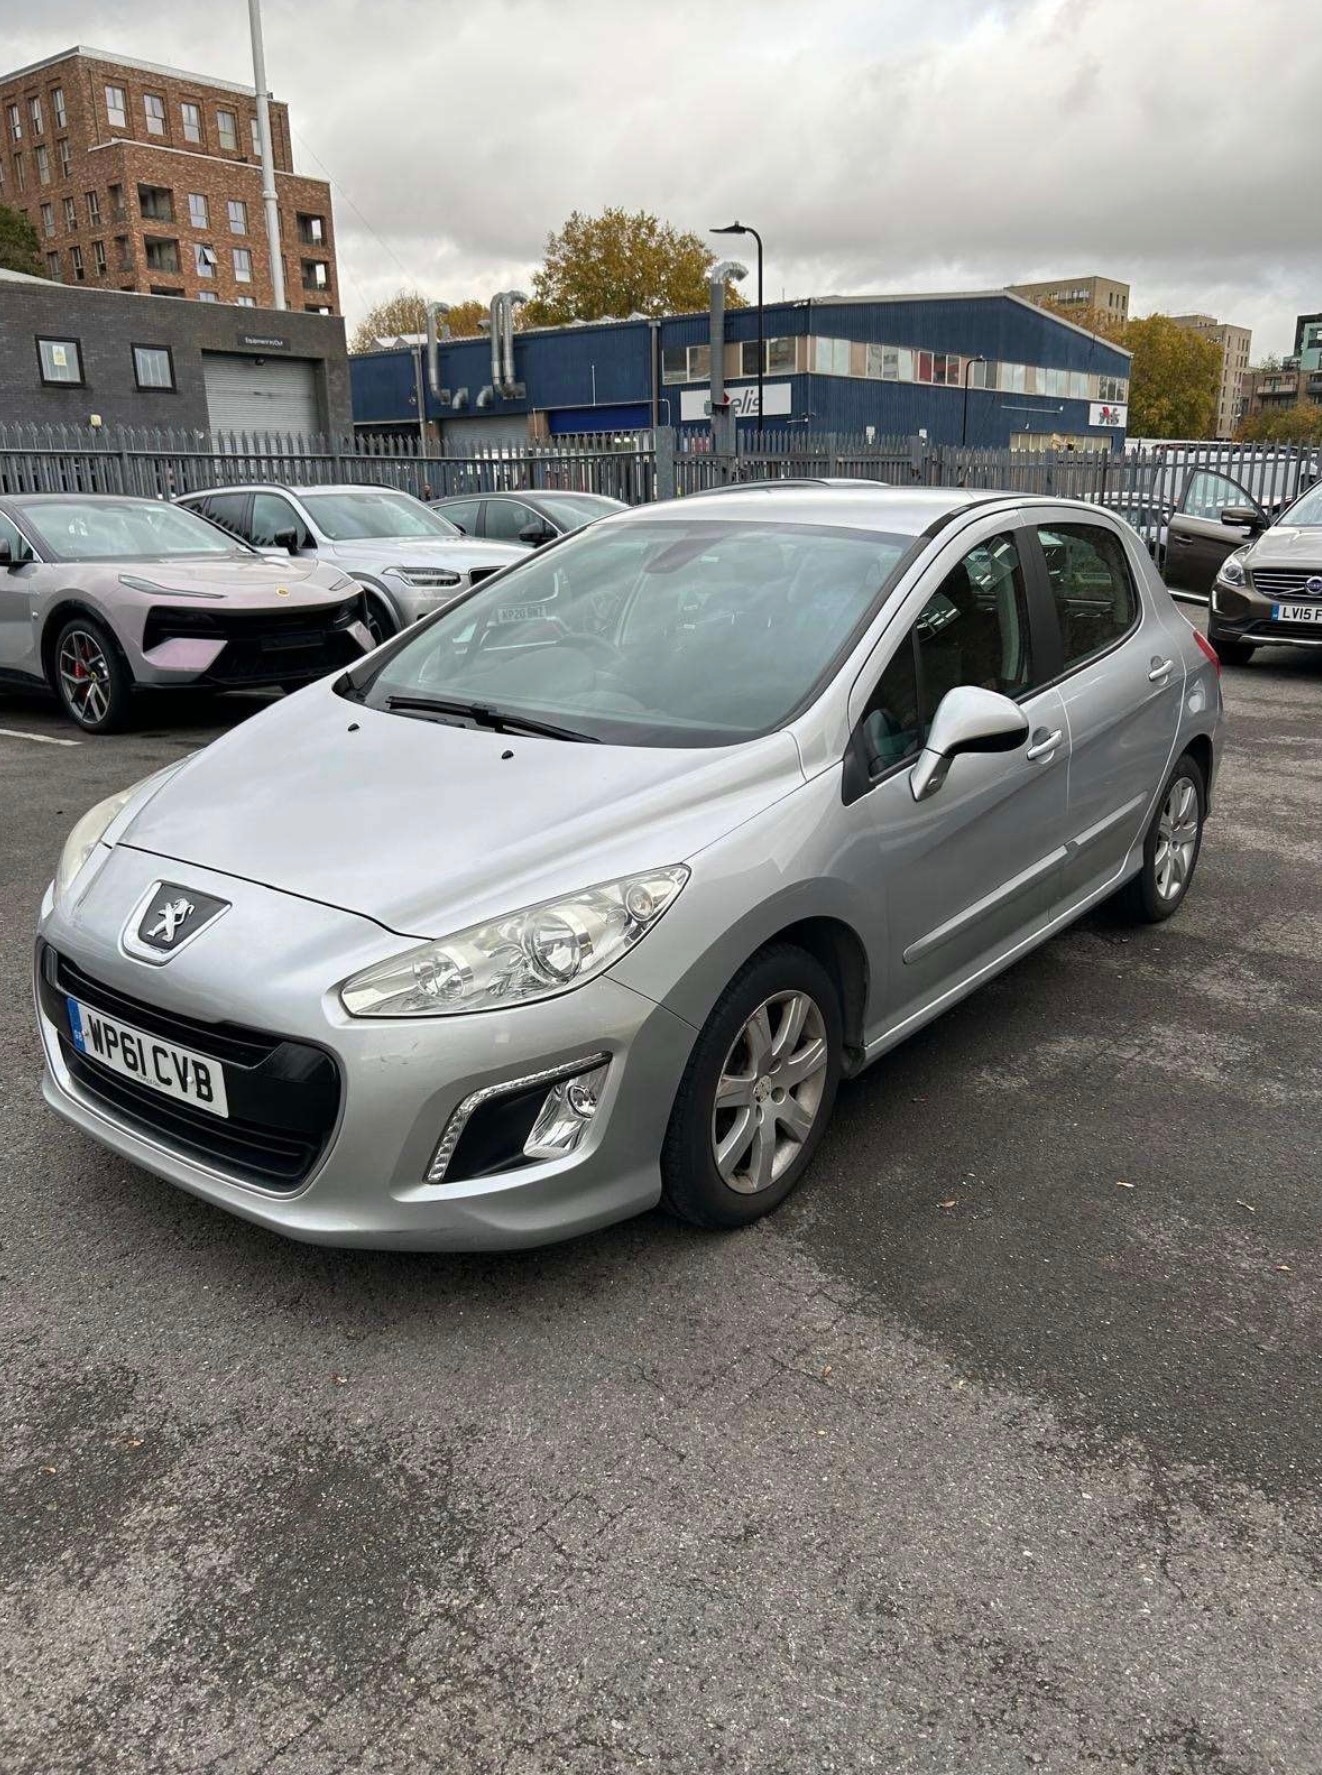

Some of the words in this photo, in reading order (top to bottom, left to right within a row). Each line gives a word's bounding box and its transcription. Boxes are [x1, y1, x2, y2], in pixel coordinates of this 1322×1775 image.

[1282, 606, 1313, 620] LV15
[87, 1013, 147, 1076] WP61
[152, 1045, 214, 1103] CVB
